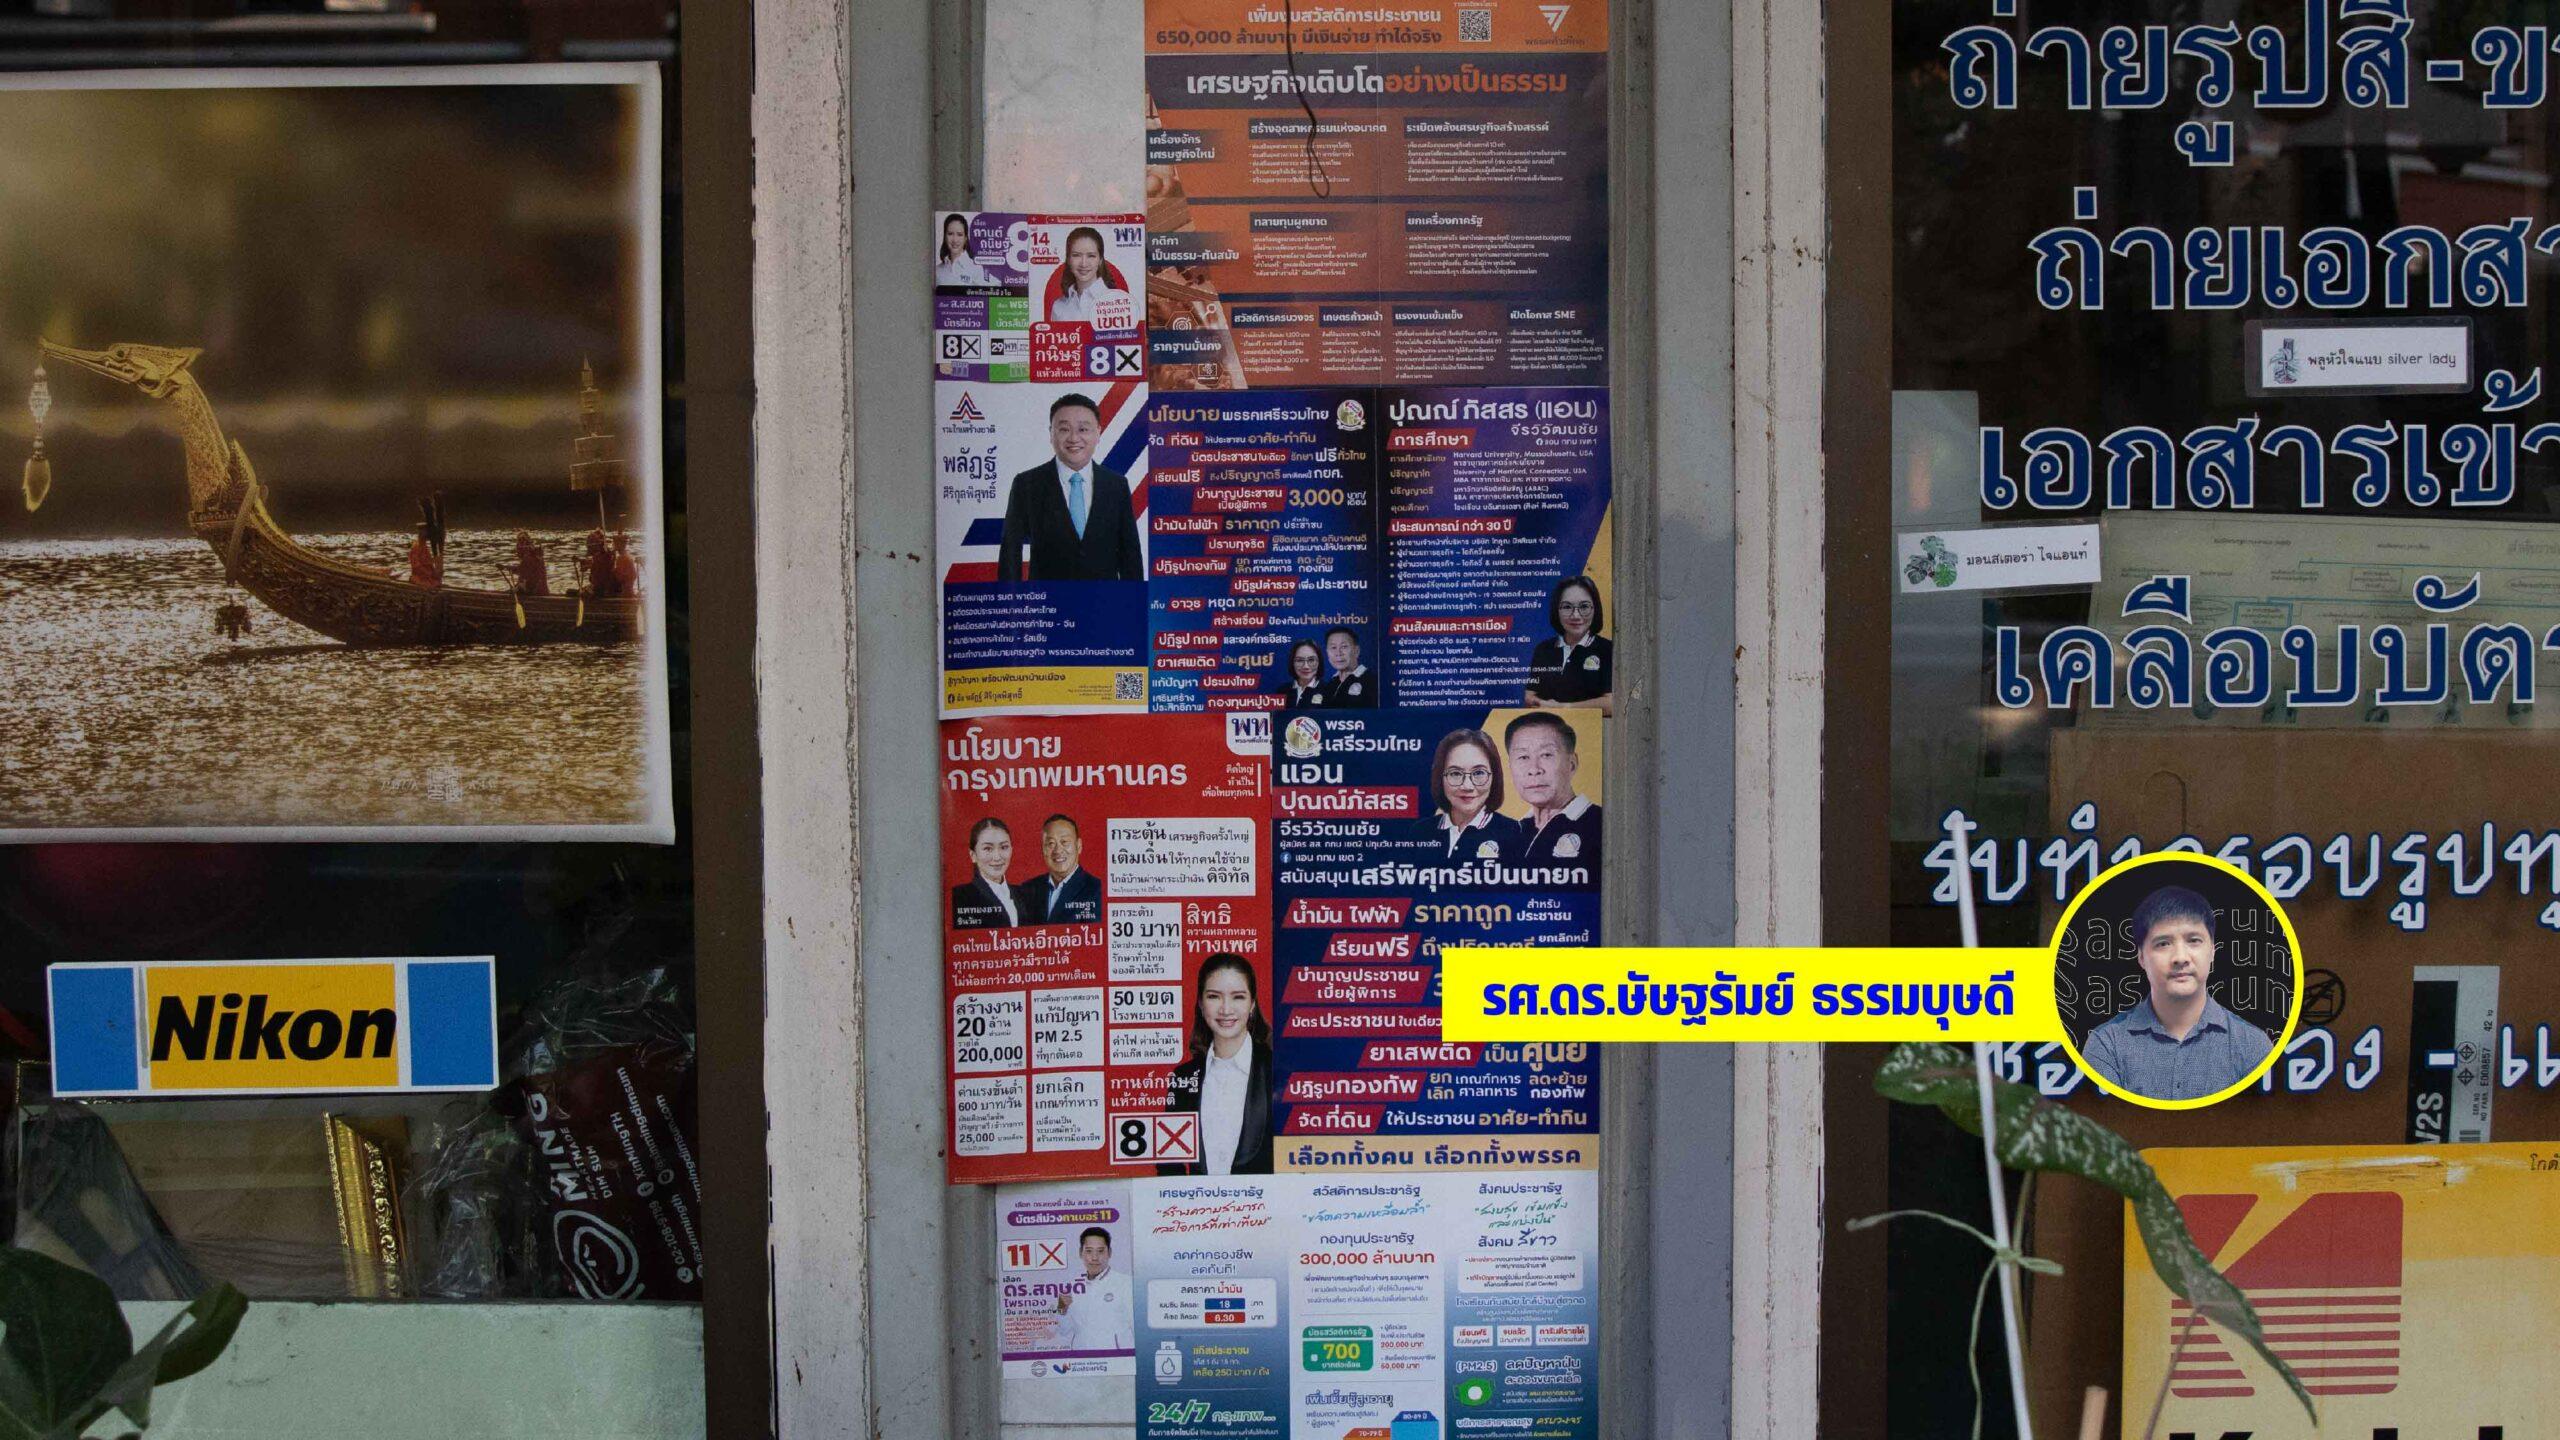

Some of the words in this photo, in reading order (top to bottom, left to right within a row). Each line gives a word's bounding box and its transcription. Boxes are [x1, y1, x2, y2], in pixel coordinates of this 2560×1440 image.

[1156, 30, 1231, 46] 650,000
[1302, 27, 1370, 44] มีเงินจ่าย
[1375, 27, 1442, 44] ทำได้จริง
[1939, 0, 2560, 167] ถายรูปส-ข
[1150, 131, 1201, 145] เครื่องจักร
[1150, 147, 1215, 162] เศรษฐกิจใหม่
[1254, 217, 1327, 229] ทลายทุนผูกขาด
[1030, 232, 1050, 246] 14
[1151, 235, 1179, 246] กติกา
[1151, 249, 1240, 262] เป็นธรรม-ทันสมัย
[1234, 312, 1315, 324] สวัสดิการครบวงจร
[1554, 310, 1576, 319] SME
[1035, 326, 1081, 344] กานต์
[946, 336, 960, 357] 8
[991, 343, 1004, 353] 29
[1153, 340, 1222, 353] รากฐานมั่นคง
[1035, 344, 1083, 368] กนิษฐ์
[1090, 346, 1111, 375] 8
[2307, 348, 2383, 371] พลูหัวใจแนบ
[2388, 352, 2423, 365] silver
[2429, 352, 2457, 368] lady
[1149, 404, 1220, 423] นโยบาย
[1222, 407, 1329, 422] พรรคเสรีรวมไทย
[1535, 400, 1597, 420] (แอน)
[1149, 434, 1164, 446] จัด
[1171, 433, 1199, 446] ที่ดิน
[1394, 429, 1469, 447] การศึกษา
[943, 445, 997, 480] พลัฏฐ์
[943, 482, 996, 504] ศิริกุลพิสุทธิ์
[1197, 488, 1283, 500] บำนาญประชาชน
[1289, 489, 1344, 509] 3,000
[1226, 517, 1280, 532] ราคาถูก
[1462, 520, 1484, 532] กว่า
[1486, 521, 1501, 532] 30
[1966, 546, 2035, 567] มอนสเตอร่า
[2039, 540, 2088, 561] ไจแอนท์
[1316, 579, 1368, 590] ประชาชน
[1393, 619, 1507, 634] งานสังคมและการเมือง
[1996, 571, 2560, 709] เคลือบบัต
[1157, 656, 1216, 668] ยาเสพติด
[1325, 719, 1365, 731] พรรค
[947, 727, 1061, 761] นโยบาย
[1325, 735, 1421, 753] เสรีรวมไทย
[947, 763, 1188, 802] กรุงเทพมหานคร
[1281, 763, 1343, 784] แอน
[1110, 821, 1167, 847] กระตุ้น
[1169, 827, 1249, 845] เศรษฐกิจครั้งใหญ่
[1280, 820, 1381, 837] จีรวิวัฒนชัย
[1111, 848, 1168, 865] เติมเงิน
[1168, 851, 1250, 869] ให้ทุกคนใช้จ่าย
[1295, 853, 1314, 862] แอน
[1338, 854, 1355, 862] เขต
[1357, 853, 1364, 862] 2
[1207, 866, 1250, 884] ดิจิทัล
[1280, 867, 1350, 888] สนับสนุน
[1352, 861, 1589, 893] เสรีพิศุทธ์เป็นนายก
[1111, 906, 1154, 918] ยกระดับ
[1186, 902, 1232, 926] สิทธิ
[1293, 898, 1343, 925] น้ำมัน
[1351, 902, 1400, 925] ไฟฟ้า
[1415, 903, 1512, 930] ราคาถูก
[1526, 898, 1561, 909] สำหรับ
[1516, 909, 1572, 922] ประชาชน
[1112, 921, 1134, 938] 30
[1139, 922, 1180, 937] บาท
[1186, 937, 1258, 954] ทางเพศ
[1330, 935, 1410, 958] เรียนฟรี
[952, 950, 1071, 973] ทุกครอบครัวมีรายได้
[1007, 971, 1045, 986] 20,000
[1297, 965, 1420, 983] บำนาญประชาชน
[1113, 991, 1135, 1006] 50
[1139, 991, 1174, 1006] เขต
[1317, 983, 1396, 1003] เบี้ยผู้พิการ
[956, 997, 1024, 1017] สร้างงาน
[1112, 1007, 1175, 1021] โรงพยาบาล
[1035, 1006, 1100, 1027] แก้ปัญหา
[150, 993, 398, 1062] Nikon
[957, 1017, 987, 1038] 20
[2483, 1021, 2493, 1032] 42
[1035, 1031, 1058, 1044] PM
[1061, 1030, 1083, 1042] 2.5
[958, 1046, 1024, 1063] 200,000
[1369, 1043, 1471, 1061] ยาเสพติด
[1485, 1045, 1518, 1063] เป็น
[1035, 1076, 1084, 1094] ยกเลิก
[1110, 1070, 1200, 1095] กานต์กนิษฐ์
[1289, 1075, 1418, 1101] ปฏิรูปกองทัพ
[1430, 1072, 1452, 1084] ยก
[1458, 1085, 1518, 1098] ศาลทหาร
[1530, 1084, 1585, 1099] กองทัพ
[958, 1101, 978, 1112] 600
[1110, 1093, 1176, 1108] แห้วสันตติ
[1325, 1105, 1371, 1128] ที่ดิน
[1386, 1109, 1475, 1127] ให้ประชาชน
[1478, 1108, 1588, 1127] อาศัย-ทำกิน
[526, 1092, 588, 1202] MING
[610, 1110, 646, 1180] XinMingTH
[959, 1132, 995, 1144] 25,000
[1120, 1120, 1148, 1157] 8
[586, 1144, 603, 1171] SUM
[1289, 1138, 1414, 1166] เลือกทั้งคน
[1425, 1138, 1582, 1165] เลือกทั้งพรรค
[559, 1126, 598, 1200] HEARTMADE
[597, 1176, 614, 1199] DIM
[1159, 1185, 1264, 1200] เศรษฐกิจประชารัฐ
[1312, 1183, 1421, 1197] สวัสดิการประชารัฐ
[1478, 1182, 1562, 1195] สังคมประชารัฐ
[1101, 1209, 1112, 1220] 11
[1320, 1231, 1415, 1247] กองทุนประชารัฐ
[1478, 1235, 1513, 1248] สังคม
[1008, 1244, 1031, 1267] 11
[1173, 1248, 1254, 1261] ลดค่าครองชีพ
[1300, 1253, 1368, 1266] 300,000
[1372, 1249, 1435, 1264] ล้านบาท
[1191, 1264, 1236, 1275] ลดทันที!
[1003, 1273, 1088, 1297] ดร.สฤษดิ์
[1180, 1285, 1215, 1294] ลดราคา
[1219, 1300, 1231, 1308] 18
[1214, 1313, 1235, 1322] 6.30
[1323, 1343, 1361, 1360] 700
[1148, 1399, 1210, 1425] 24/7
